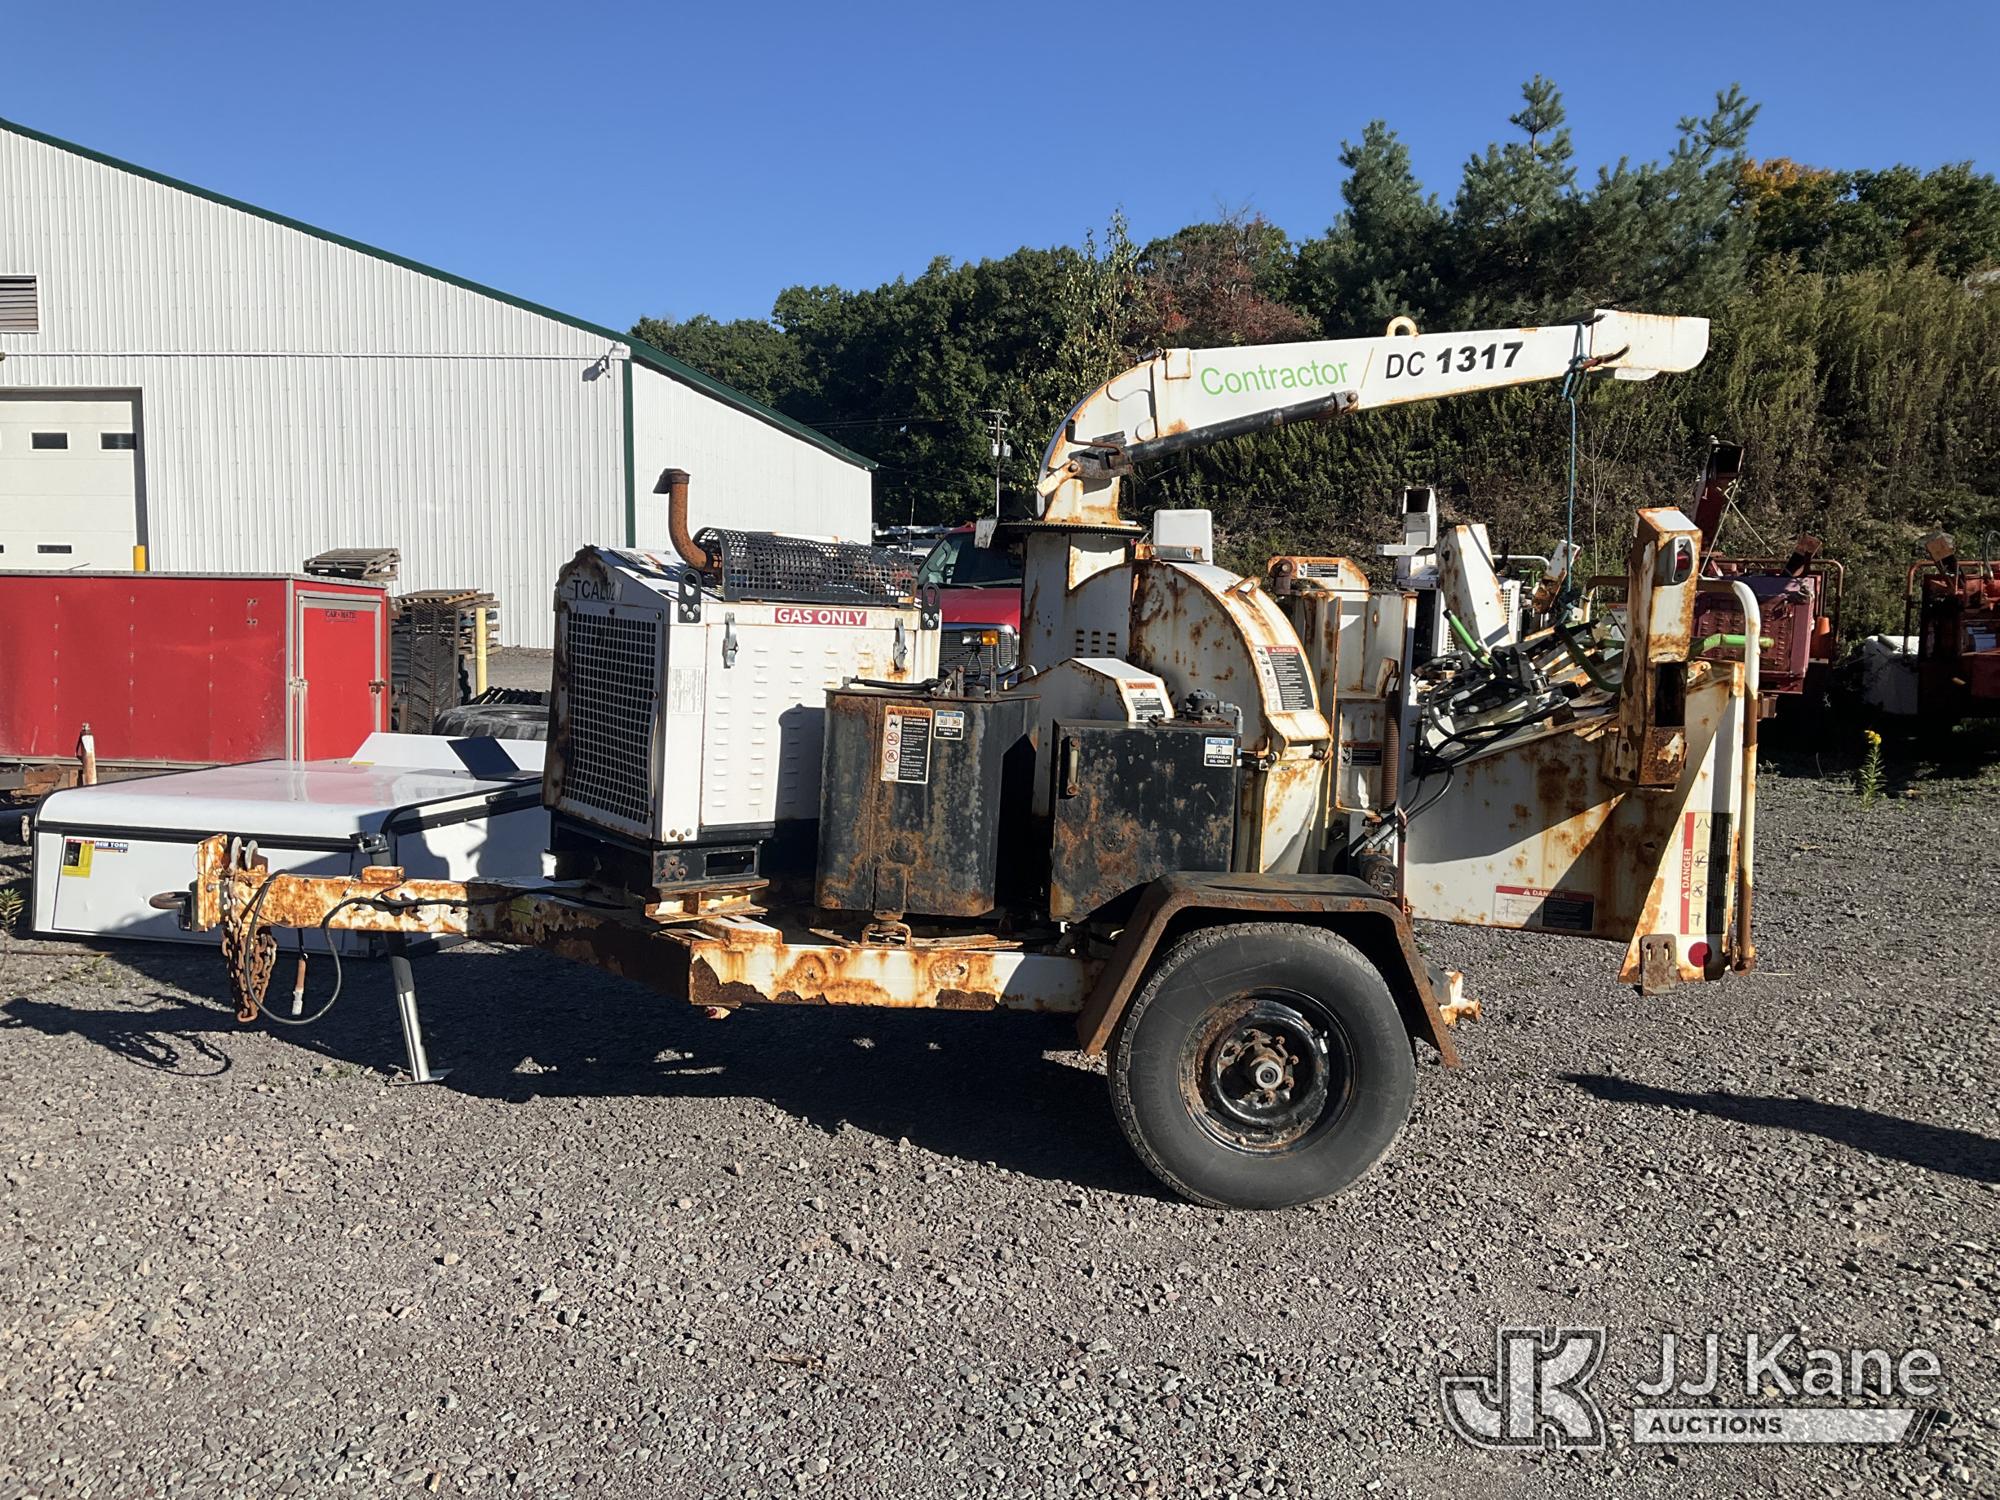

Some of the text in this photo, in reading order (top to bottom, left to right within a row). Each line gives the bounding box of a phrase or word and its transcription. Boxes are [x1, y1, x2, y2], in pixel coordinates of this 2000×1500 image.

[1200, 341, 1524, 396] Contractor DC 1317
[777, 608, 864, 625] GAS ONLY
[897, 708, 929, 717] WARNING
[1681, 848, 1693, 889] DANGER
